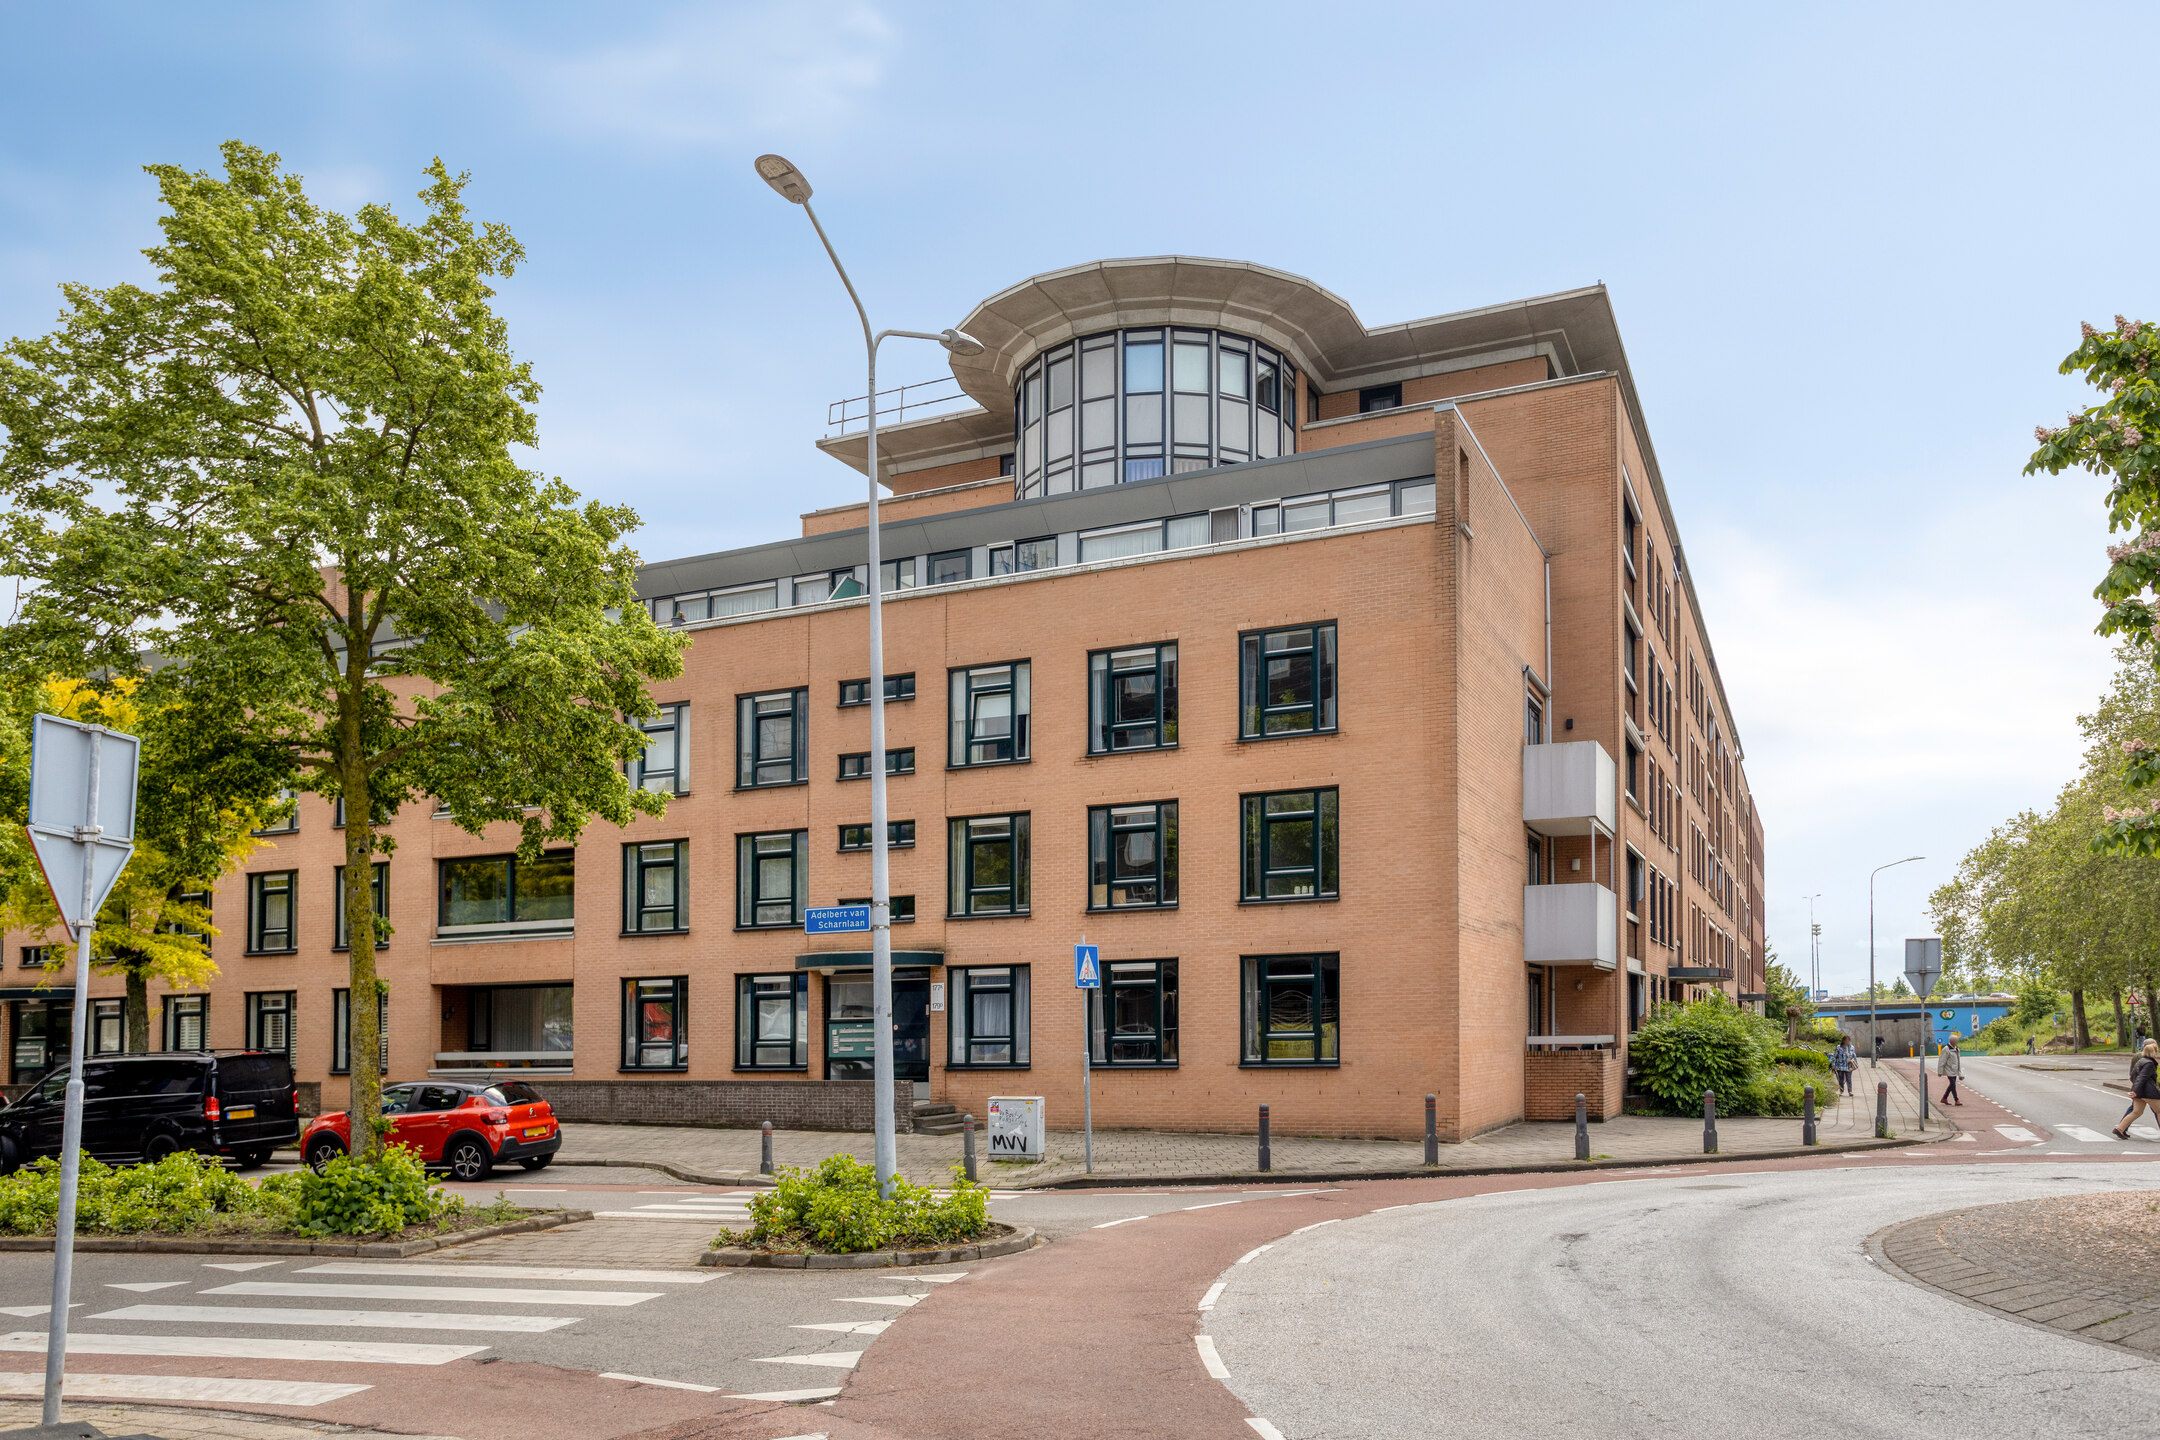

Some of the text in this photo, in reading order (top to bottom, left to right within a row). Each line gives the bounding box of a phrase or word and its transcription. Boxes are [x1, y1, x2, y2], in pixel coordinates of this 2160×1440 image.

[811, 911, 848, 919] Adelbert
[819, 920, 865, 928] Scharnlaan
[992, 1135, 1027, 1153] MVV
